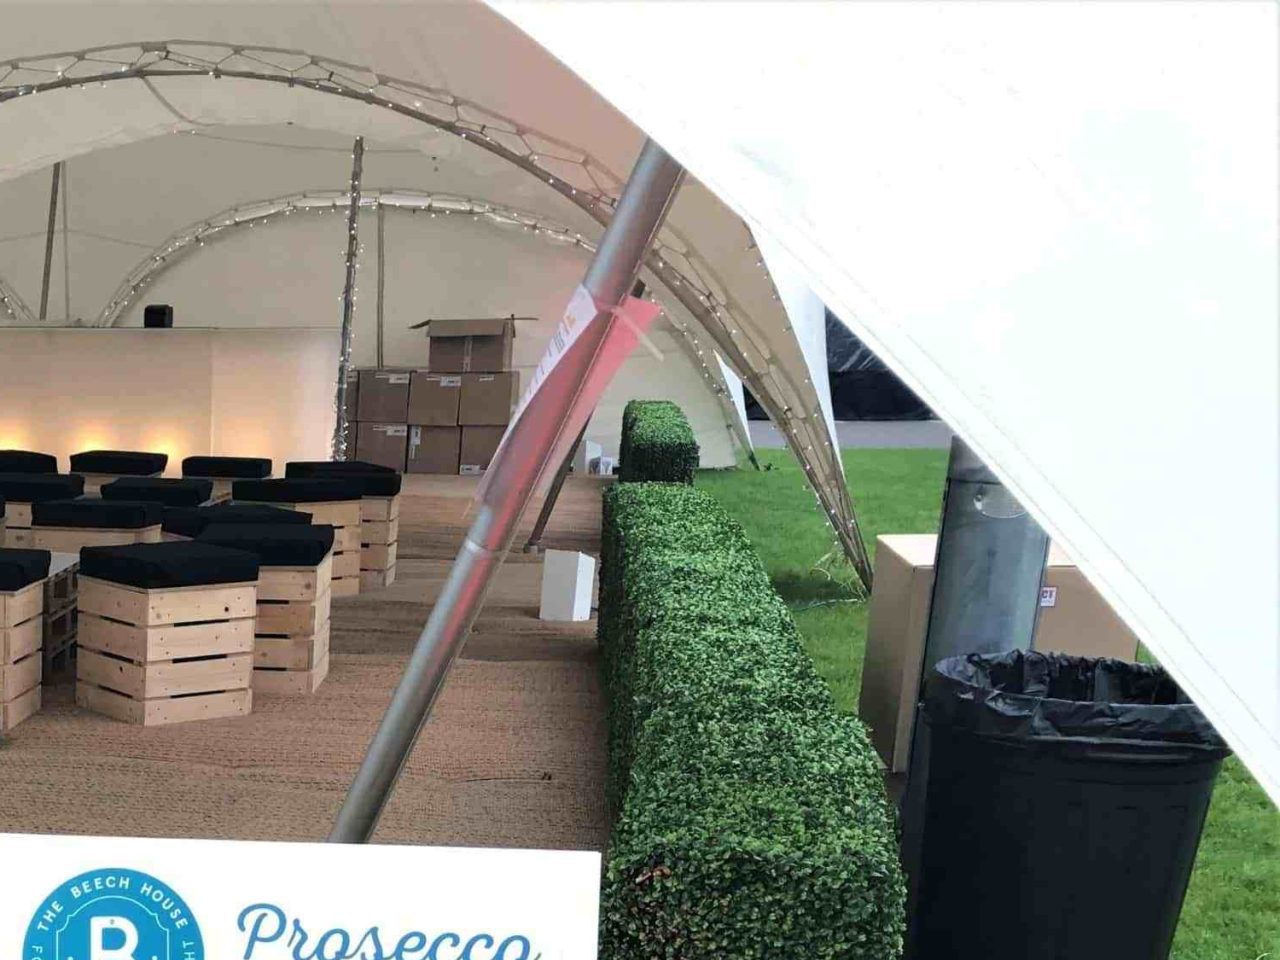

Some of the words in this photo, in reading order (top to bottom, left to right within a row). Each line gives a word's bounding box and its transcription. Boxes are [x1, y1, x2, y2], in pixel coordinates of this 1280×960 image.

[37, 900, 64, 932] THE
[70, 876, 130, 899] BEECH
[140, 882, 189, 929] HOUSE
